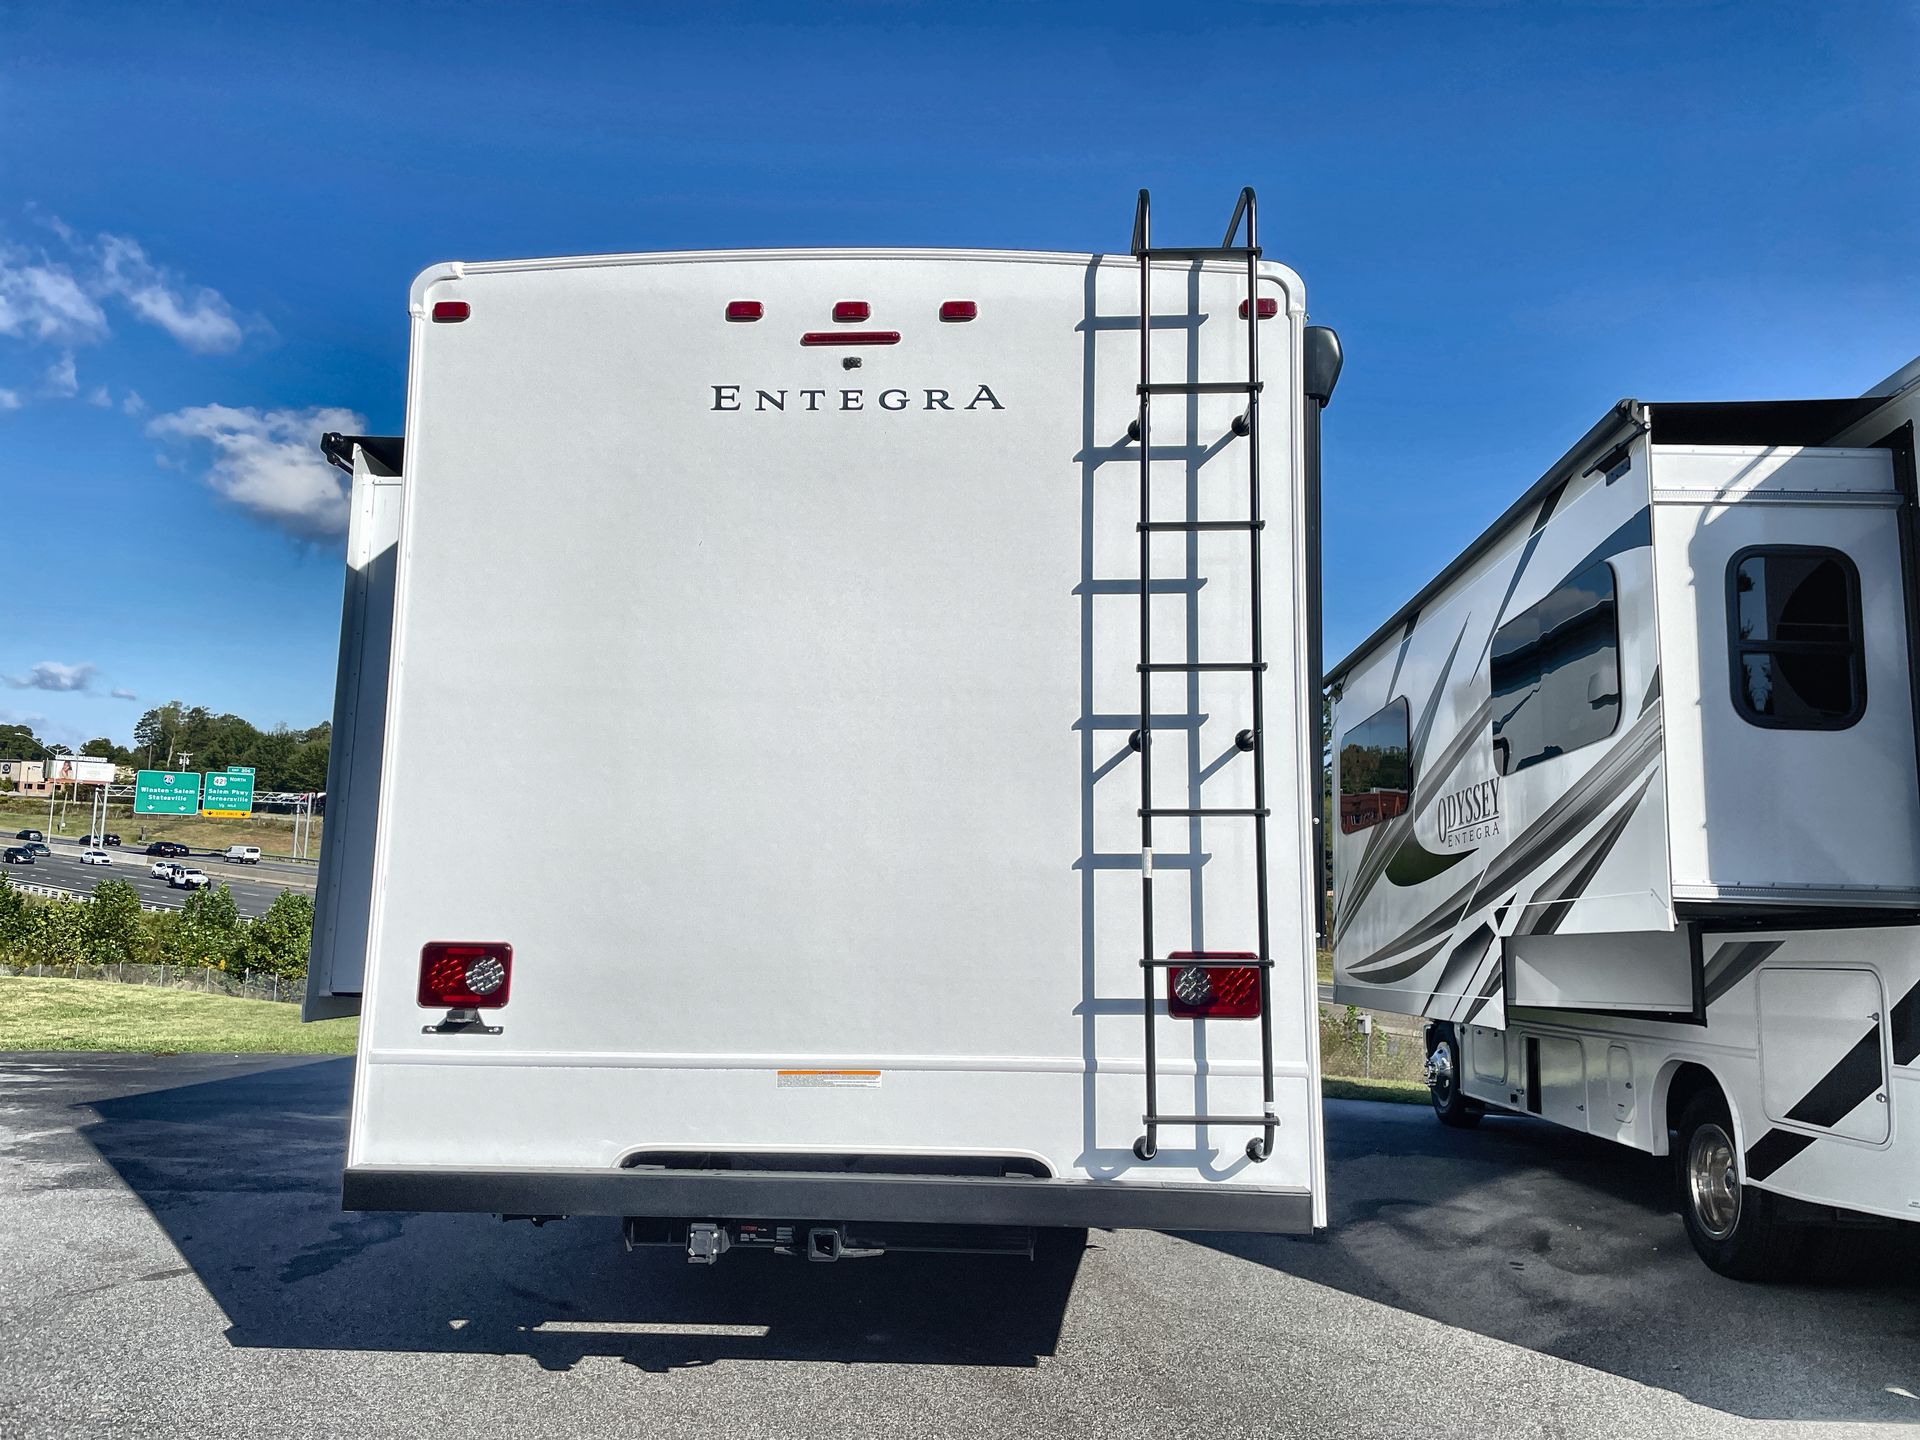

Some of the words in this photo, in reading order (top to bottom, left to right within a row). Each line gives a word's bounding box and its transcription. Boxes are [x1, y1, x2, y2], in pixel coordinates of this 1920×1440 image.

[710, 384, 1005, 411] ENTEGRA
[140, 786, 196, 795] Winston-Salem
[207, 795, 249, 803] Kernersville
[1438, 777, 1500, 843] ODYSSEY
[1448, 822, 1500, 848] ENTEGRA
